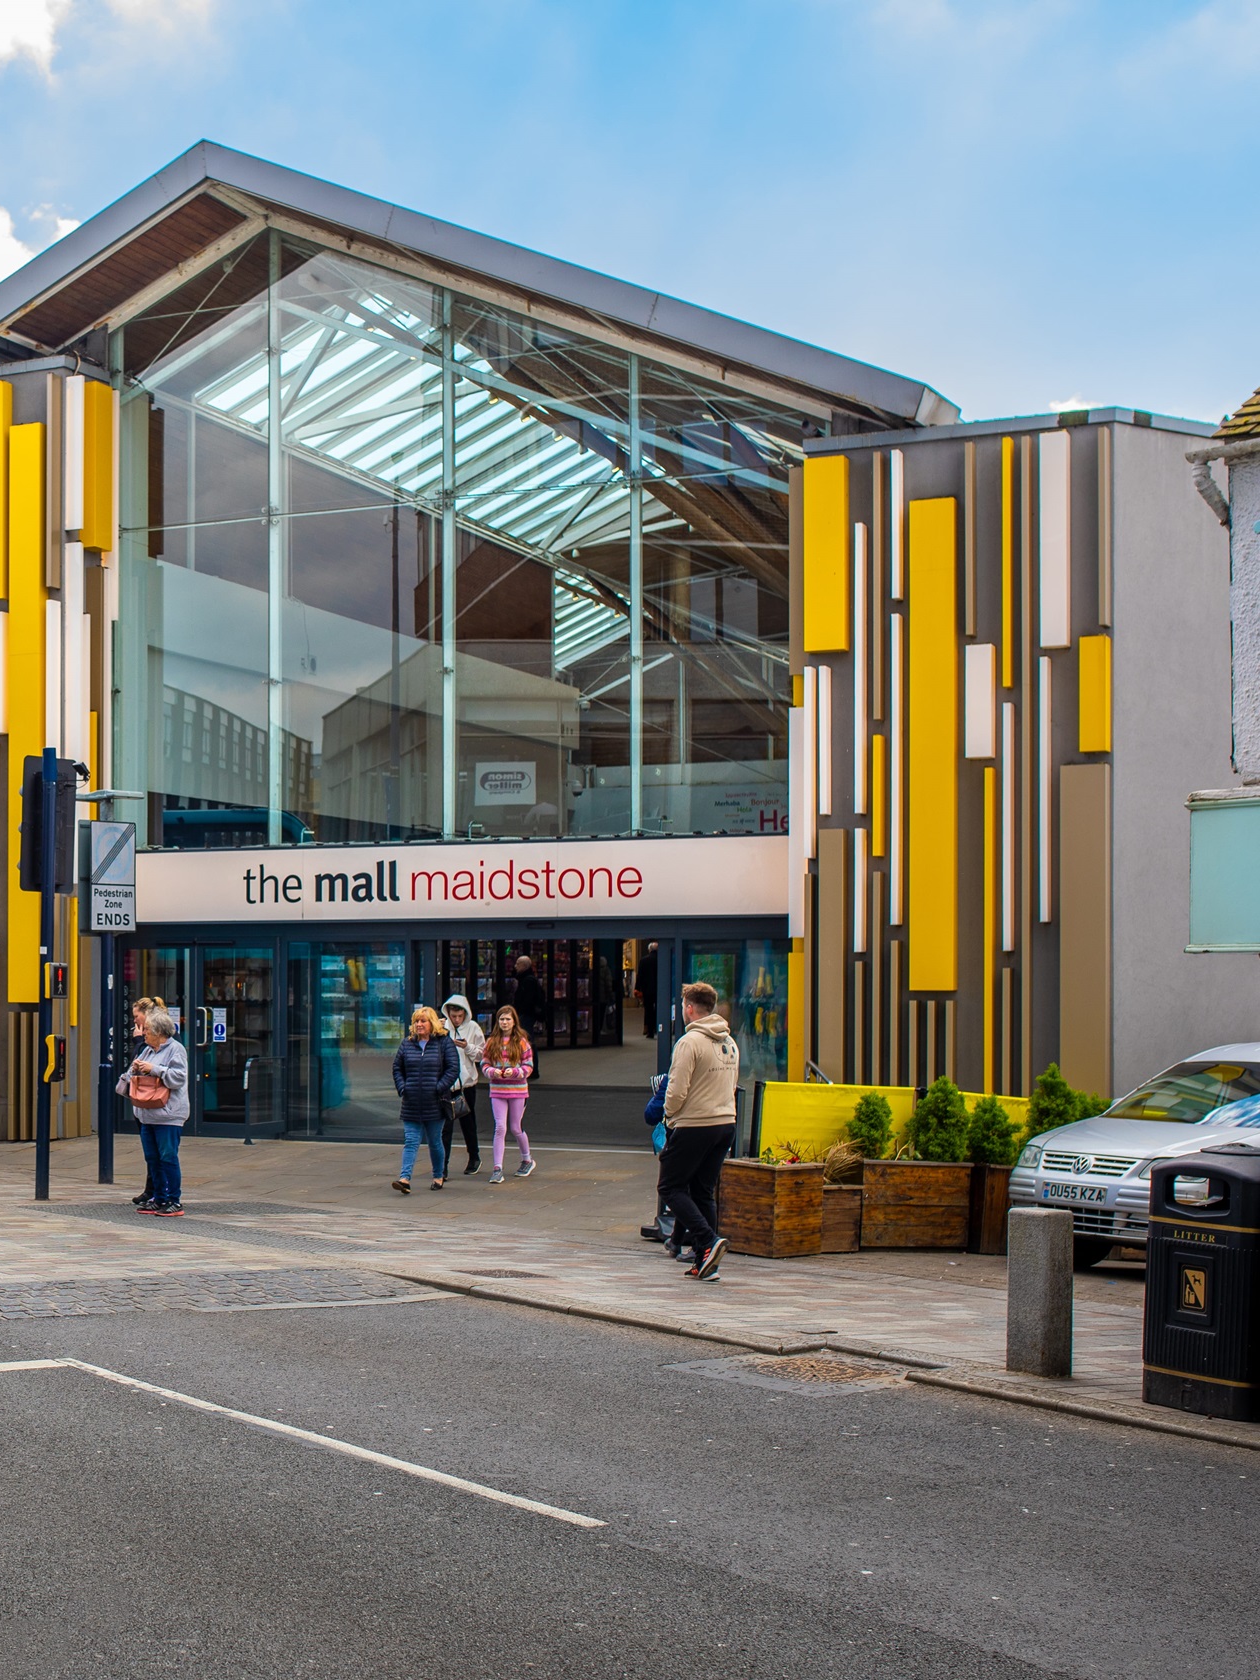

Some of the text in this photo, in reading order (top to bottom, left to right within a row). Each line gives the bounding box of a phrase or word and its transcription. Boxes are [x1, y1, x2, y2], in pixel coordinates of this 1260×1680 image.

[750, 798, 780, 807] Bonjour
[242, 860, 643, 904] the mall maidstone
[93, 888, 133, 898] Pedestrian
[104, 899, 123, 908] Zone
[96, 913, 130, 926] ENDS
[1050, 1184, 1103, 1202] OU55 KZA
[1173, 1230, 1216, 1243] LITTER
